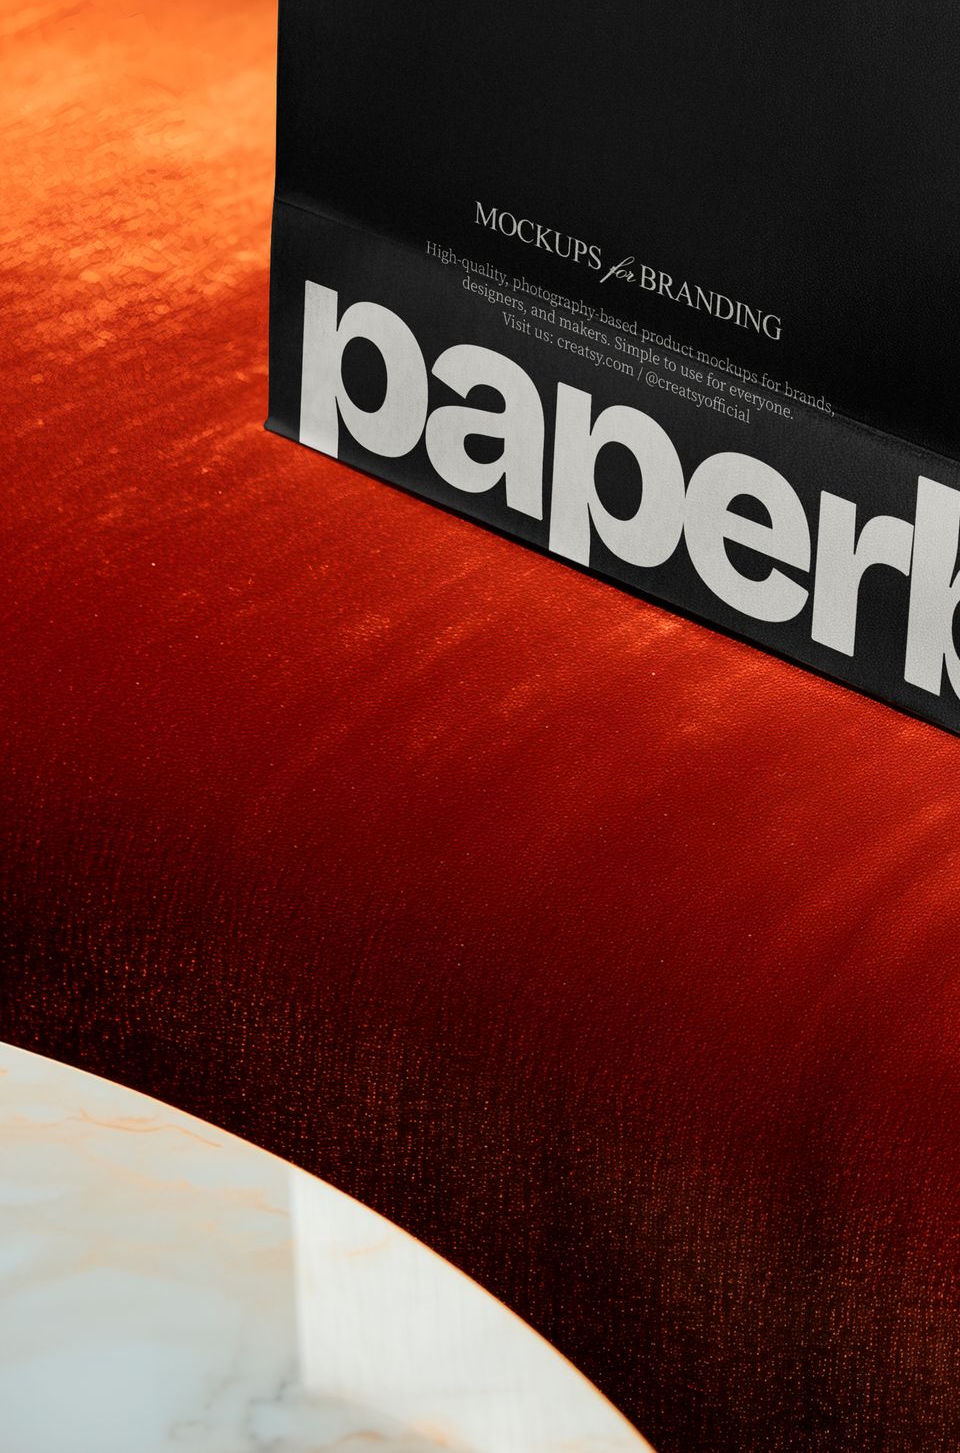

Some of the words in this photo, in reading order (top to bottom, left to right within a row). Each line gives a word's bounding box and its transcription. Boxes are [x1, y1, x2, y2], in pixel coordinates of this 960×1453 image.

[425, 240, 509, 287] High-quality,
[513, 276, 638, 336] photography-based
[641, 328, 694, 358] product
[697, 350, 758, 384] mockups
[761, 372, 782, 392] for
[784, 380, 835, 417] brands,
[474, 200, 602, 270] MOCKUPS
[599, 255, 637, 283] for
[639, 264, 783, 341] BRANDING
[462, 276, 527, 315] designers,
[531, 305, 556, 324] and
[559, 316, 610, 346] makers.
[614, 336, 660, 365] Simple
[664, 355, 677, 372] to
[681, 365, 703, 383] use
[706, 372, 726, 392] for
[729, 385, 794, 420] everyone.
[502, 311, 531, 336] Visit
[534, 327, 553, 344] us:
[557, 337, 634, 376] creatsy.com
[645, 371, 750, 424] @creatsyofficial
